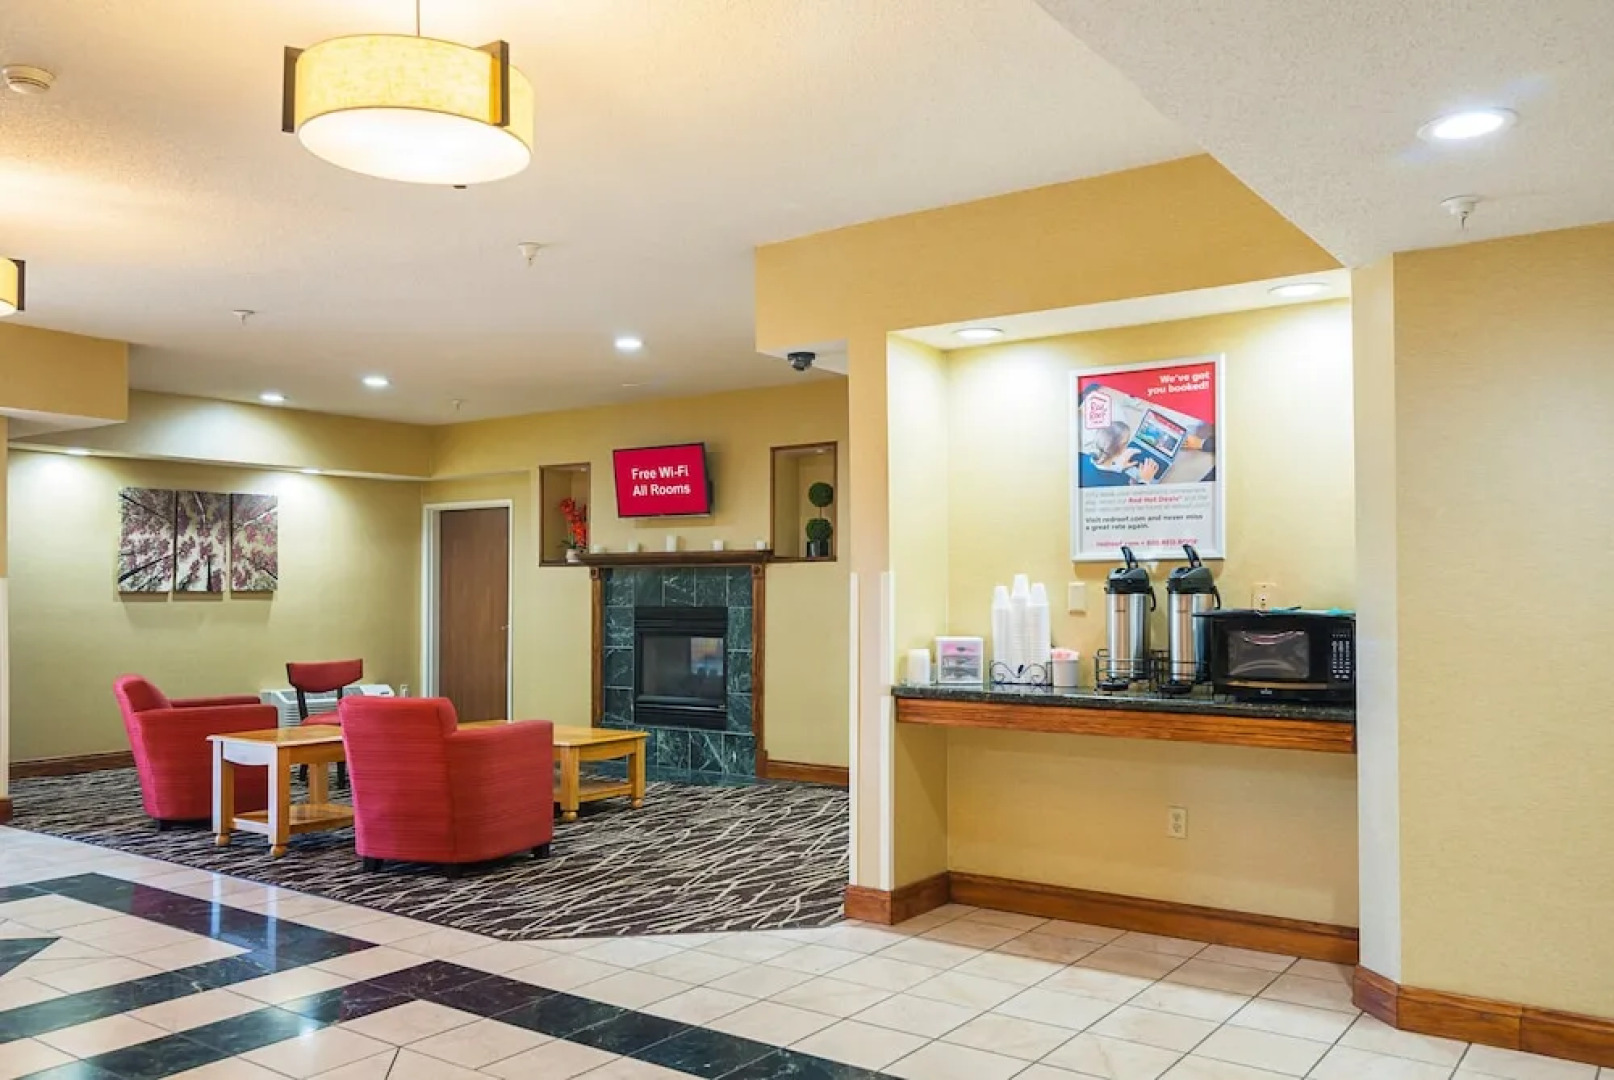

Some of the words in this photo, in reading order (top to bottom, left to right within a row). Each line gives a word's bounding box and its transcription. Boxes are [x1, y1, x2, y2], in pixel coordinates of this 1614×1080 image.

[1160, 373, 1189, 383] We've
[1192, 372, 1210, 382] got
[1147, 387, 1166, 396] you
[631, 468, 657, 480] Free
[658, 465, 689, 478] Wi-Fi
[632, 484, 648, 496] All
[650, 483, 691, 496] Rooms
[1091, 524, 1109, 532] great
